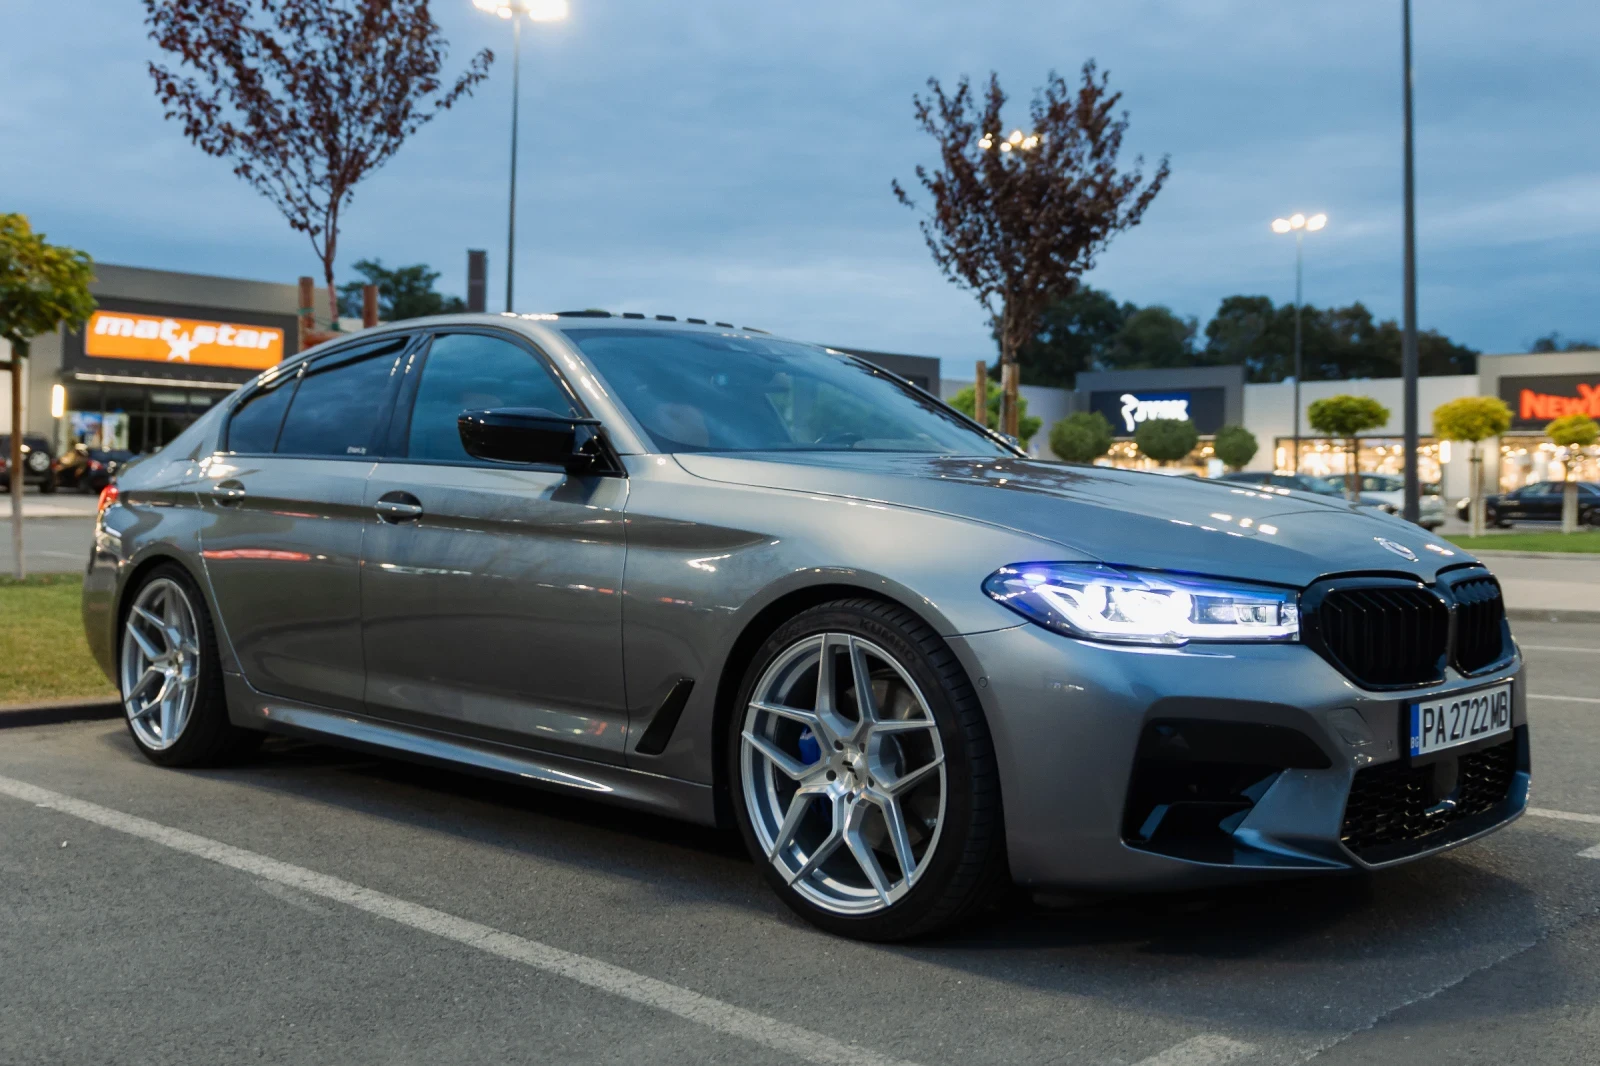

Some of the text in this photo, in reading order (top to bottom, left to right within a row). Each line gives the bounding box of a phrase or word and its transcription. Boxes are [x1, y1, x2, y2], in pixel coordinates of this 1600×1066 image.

[859, 617, 916, 662] KUMHO
[1422, 690, 1508, 748] PA 2722 MB
[1410, 737, 1419, 749] BG
